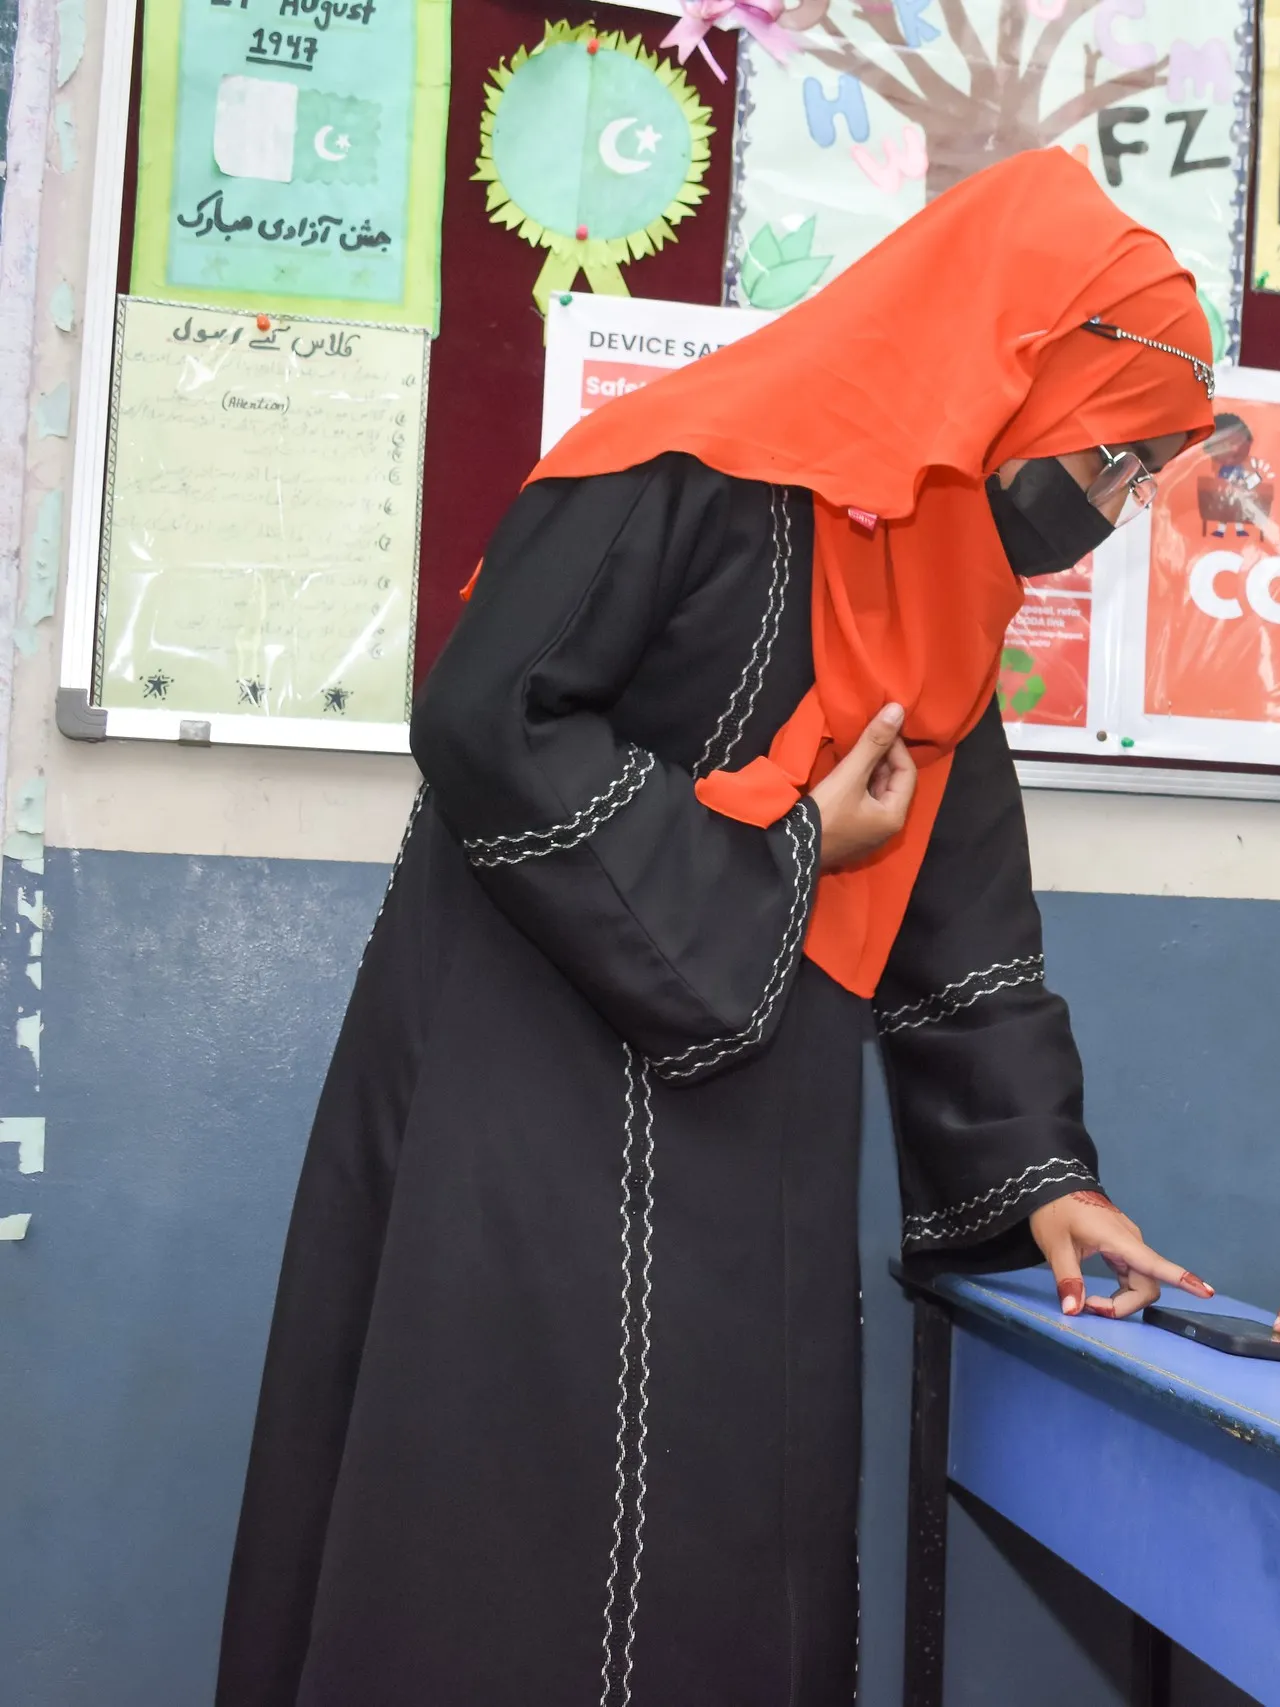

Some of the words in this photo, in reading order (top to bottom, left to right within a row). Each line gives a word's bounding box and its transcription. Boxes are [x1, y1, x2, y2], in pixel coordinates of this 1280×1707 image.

[249, 28, 318, 63] 1947
[803, 74, 870, 148] H
[1099, 106, 1149, 187] F
[1164, 108, 1230, 177] Z
[589, 330, 676, 356] DEVICE
